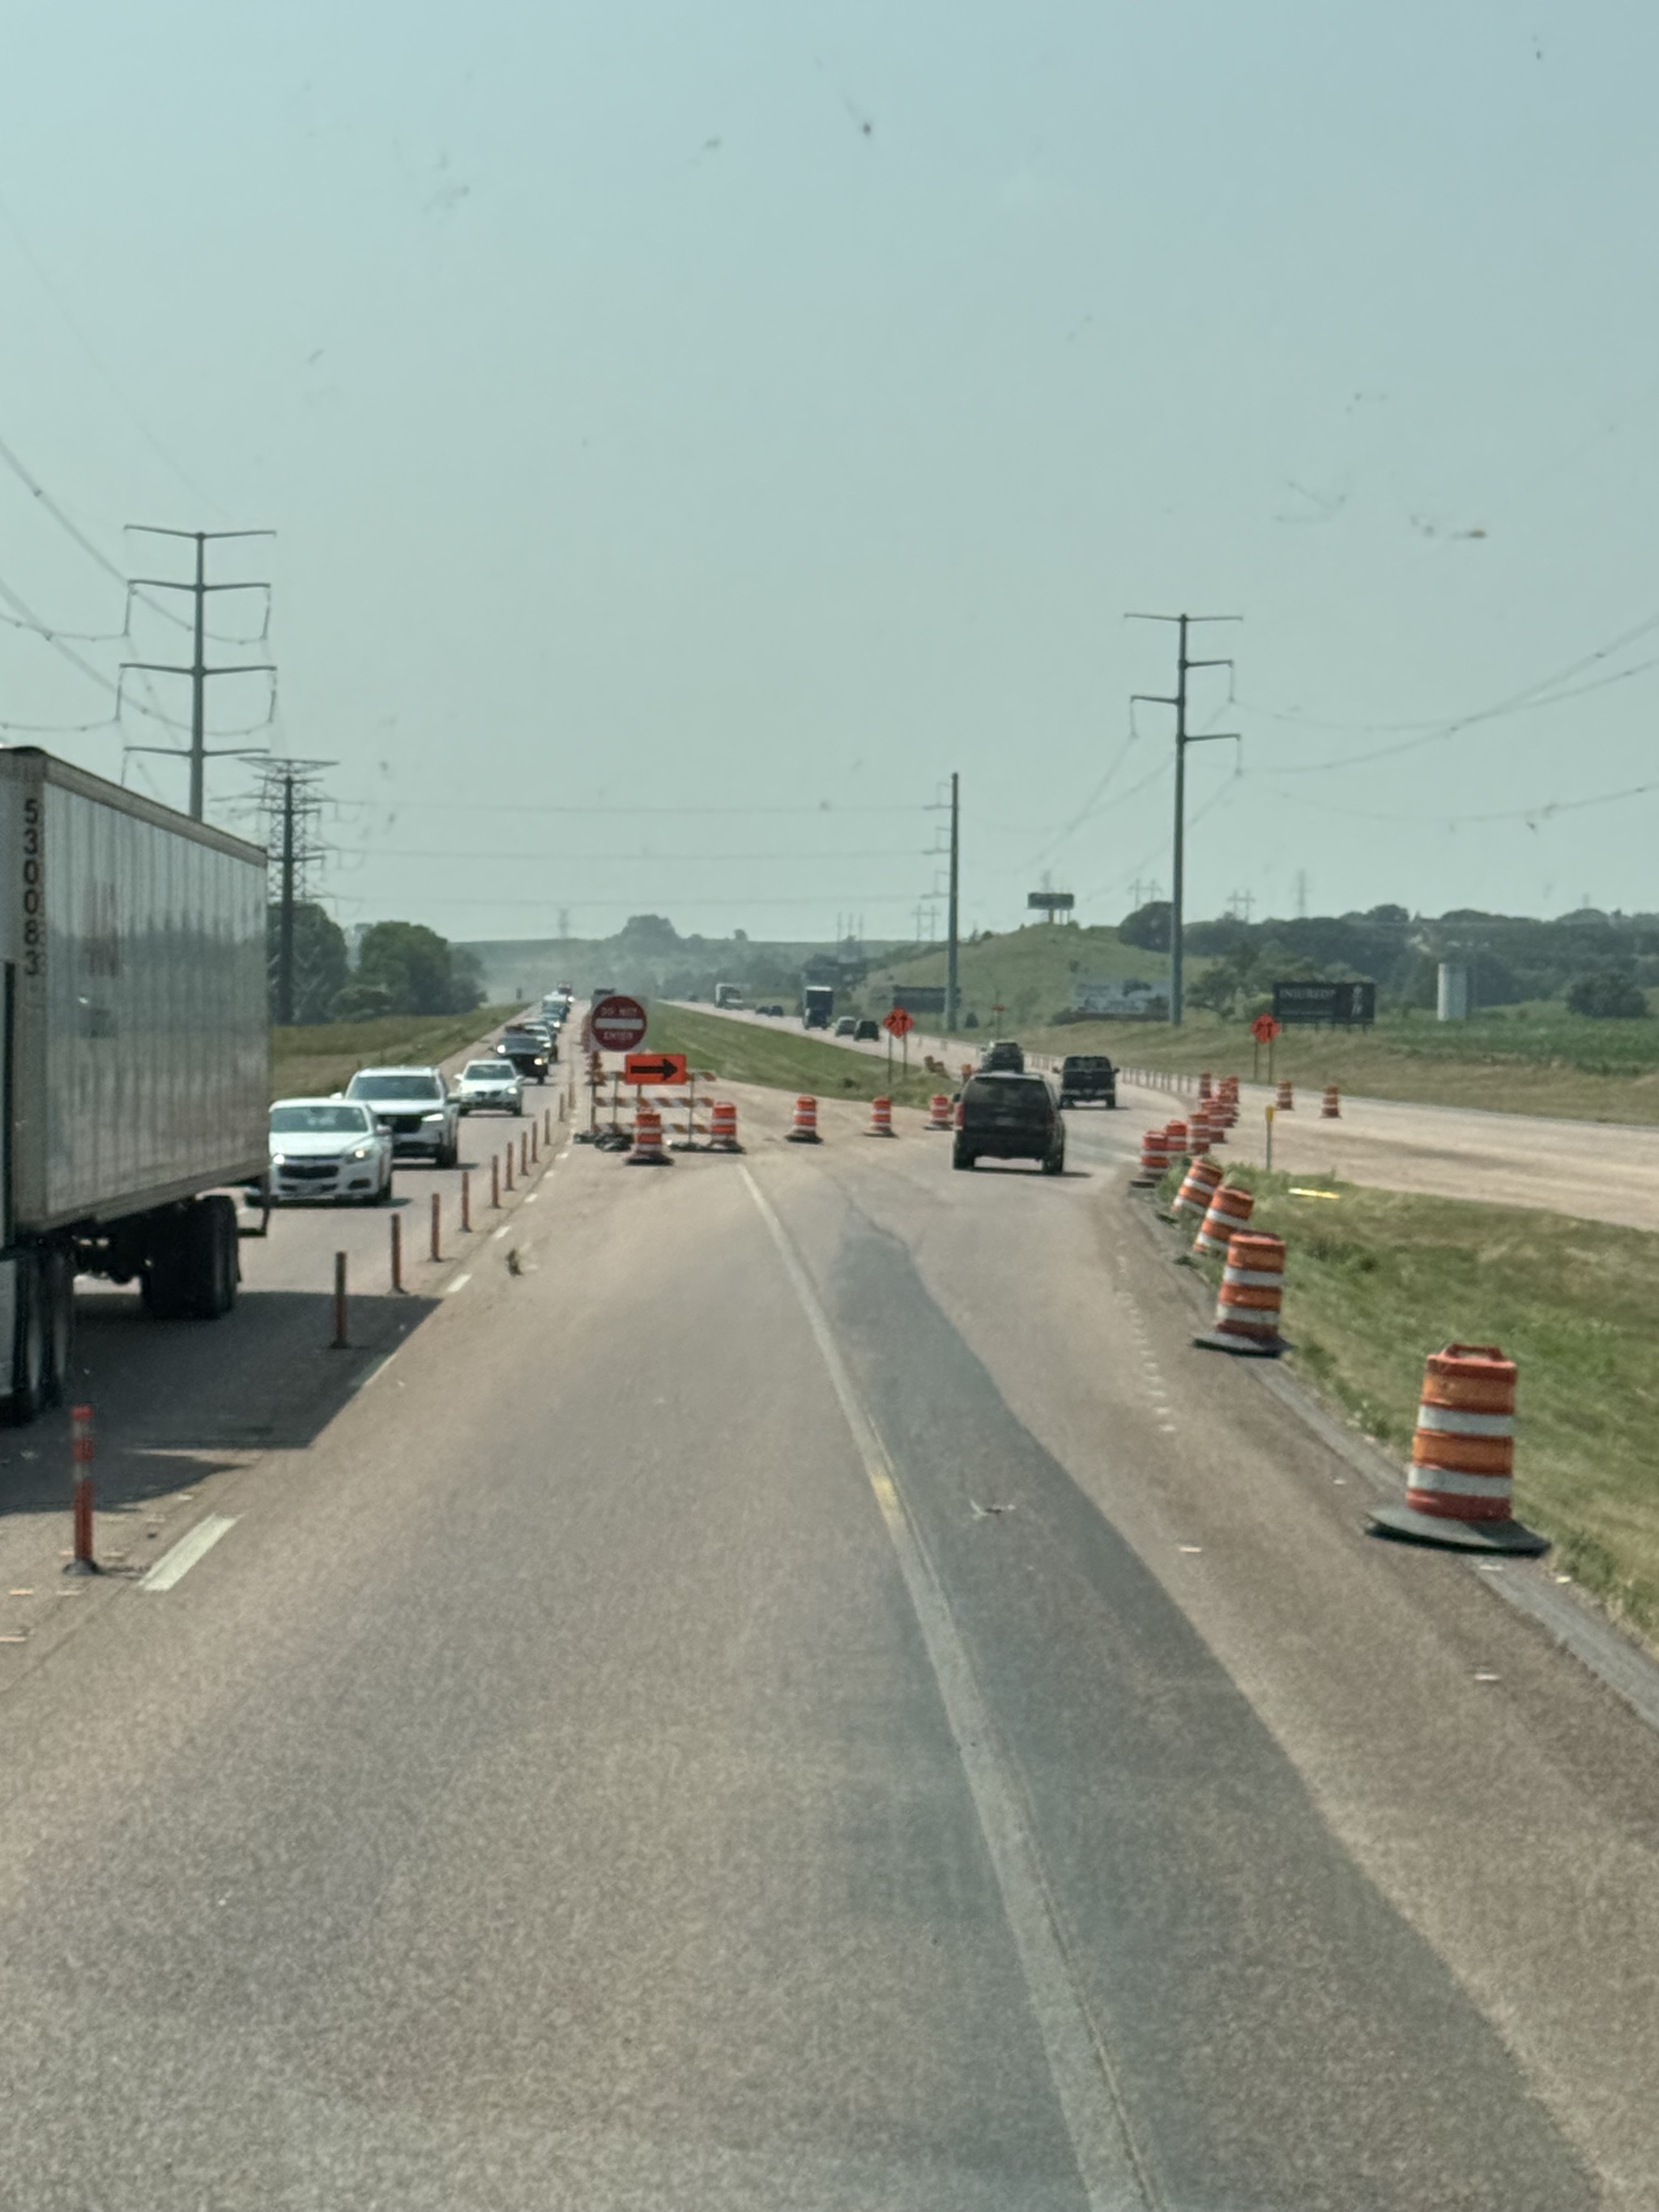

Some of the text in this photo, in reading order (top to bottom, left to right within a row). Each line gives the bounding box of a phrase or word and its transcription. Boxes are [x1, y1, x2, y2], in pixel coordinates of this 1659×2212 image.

[23, 797, 40, 976] 530083
[600, 1006, 638, 1016] DO NOT
[603, 1031, 633, 1041] ENTER
